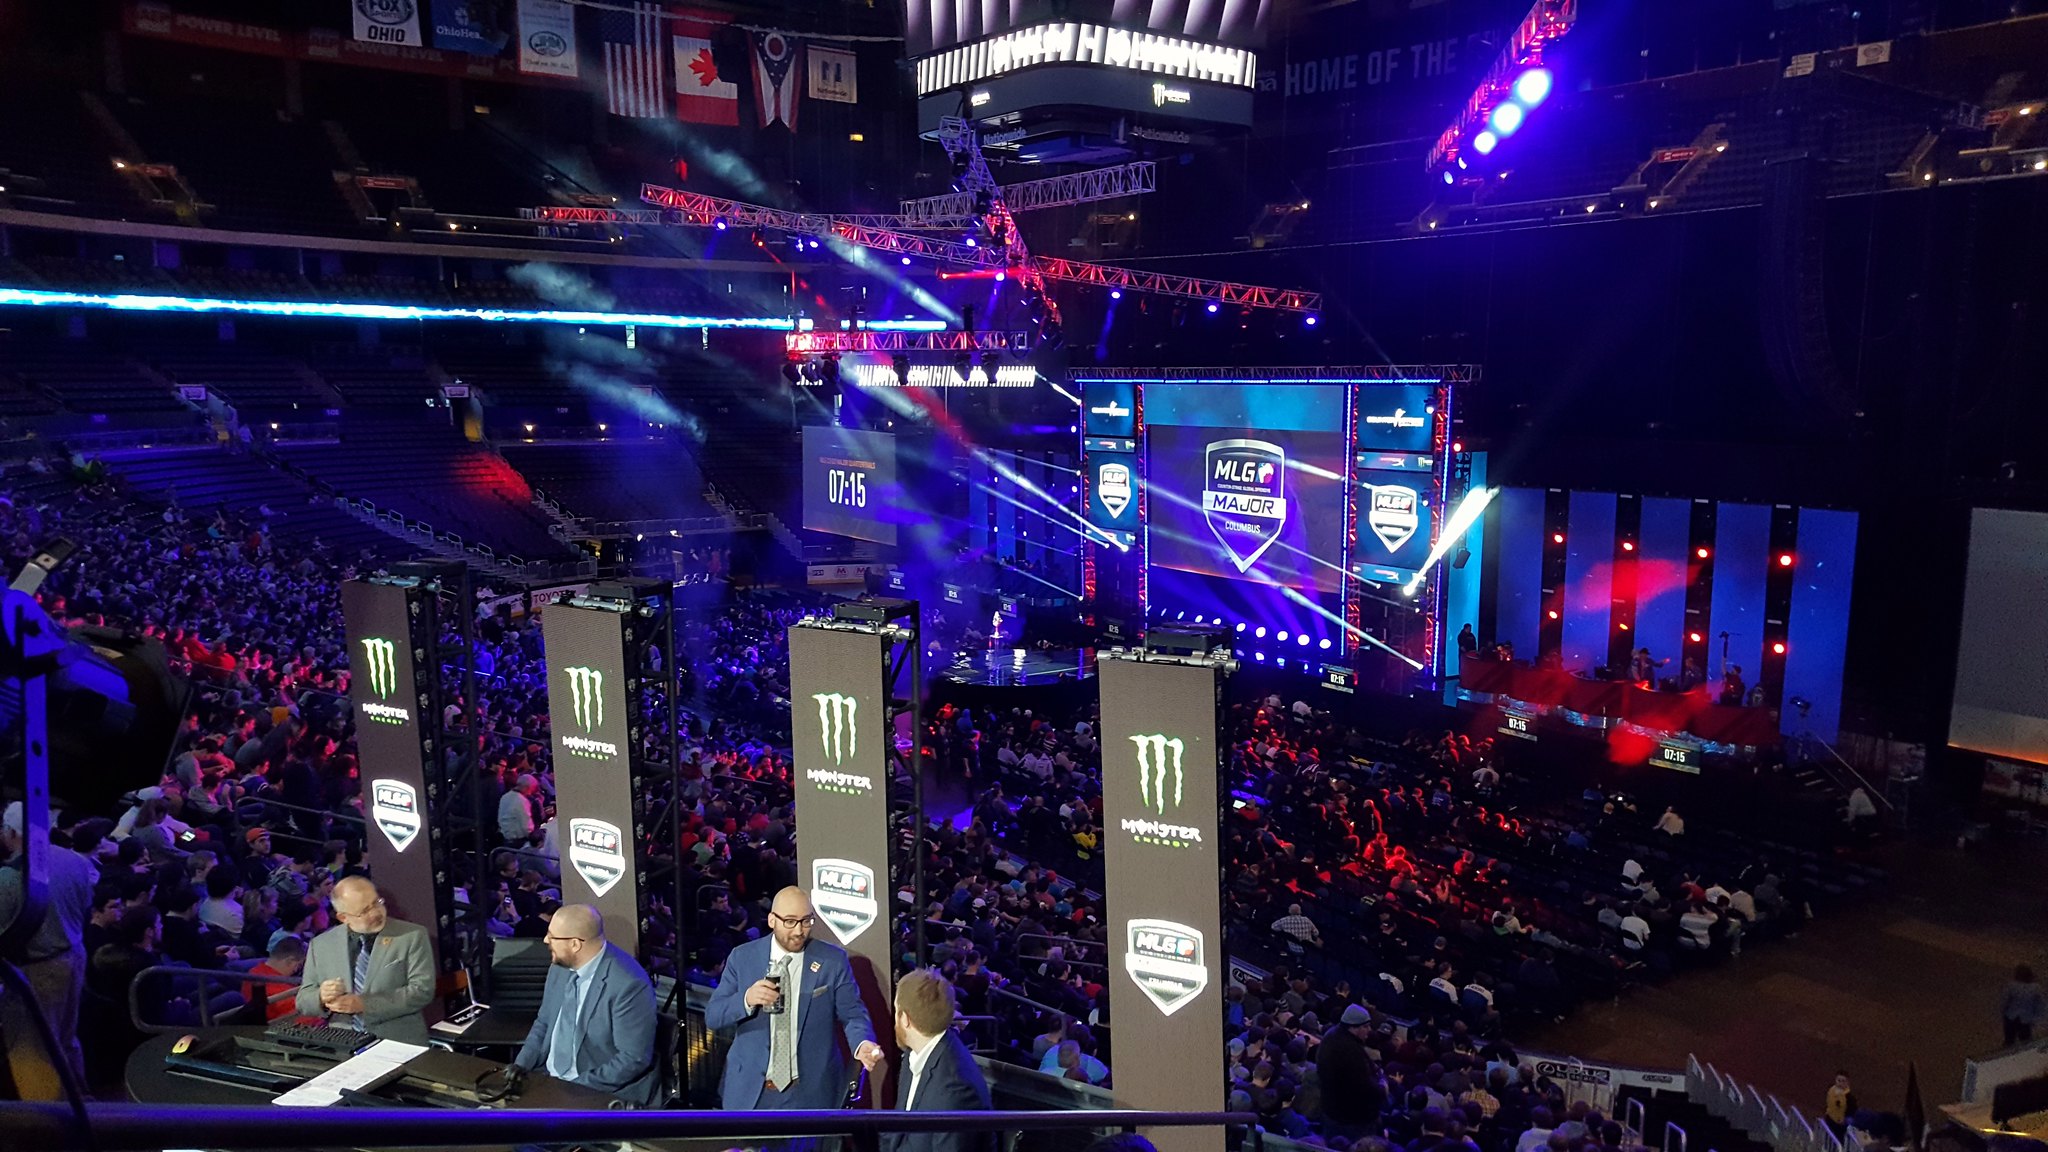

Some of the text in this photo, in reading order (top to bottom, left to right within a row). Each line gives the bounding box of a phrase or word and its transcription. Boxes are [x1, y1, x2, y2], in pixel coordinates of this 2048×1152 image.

[367, 25, 406, 43] OHIO
[436, 25, 484, 40] OhioHea
[1285, 54, 1359, 97] HOME
[1366, 47, 1401, 85] OF
[1410, 37, 1459, 79] THE
[984, 127, 1027, 144] Nationwide
[1133, 125, 1190, 144] Nationwide
[1214, 459, 1256, 483] MLG
[829, 469, 866, 508] 07:15
[1212, 494, 1275, 514] MAJOR
[1225, 520, 1261, 534] COLUMBUS
[1330, 673, 1345, 685] 07:15
[362, 703, 409, 720] MONSTER
[1508, 717, 1527, 731] 07:15
[562, 735, 618, 756] MONSTER
[1664, 748, 1686, 763] 07:15
[806, 768, 873, 790] MONSTER
[1121, 818, 1202, 842] MONSTER
[1133, 835, 1190, 848] ENERGY
[820, 870, 853, 889] MLG
[1136, 931, 1176, 953] MLG
